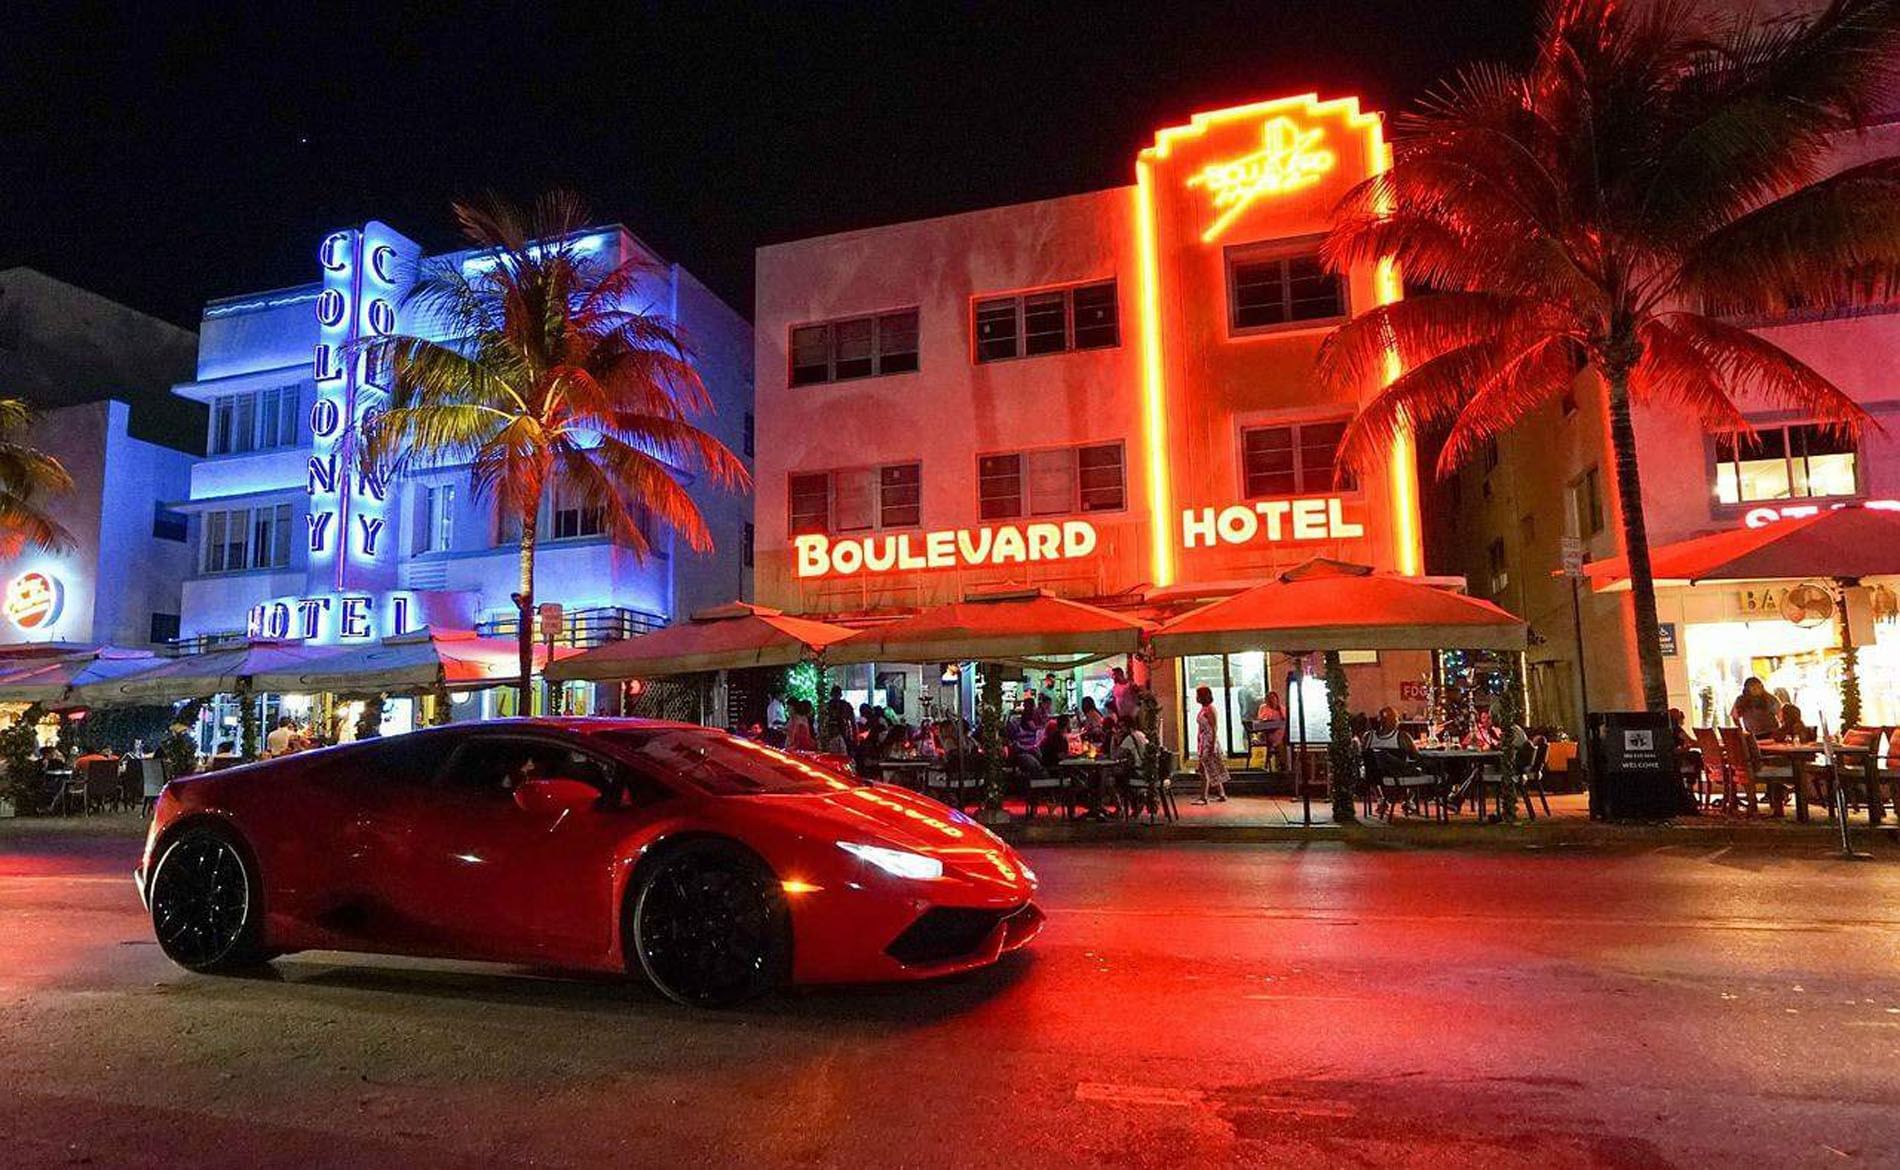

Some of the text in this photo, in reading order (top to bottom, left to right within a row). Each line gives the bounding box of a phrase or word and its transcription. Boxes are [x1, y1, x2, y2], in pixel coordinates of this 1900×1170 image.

[305, 232, 348, 552] COLONY
[794, 497, 1365, 578] BOULEVARD HOTEL
